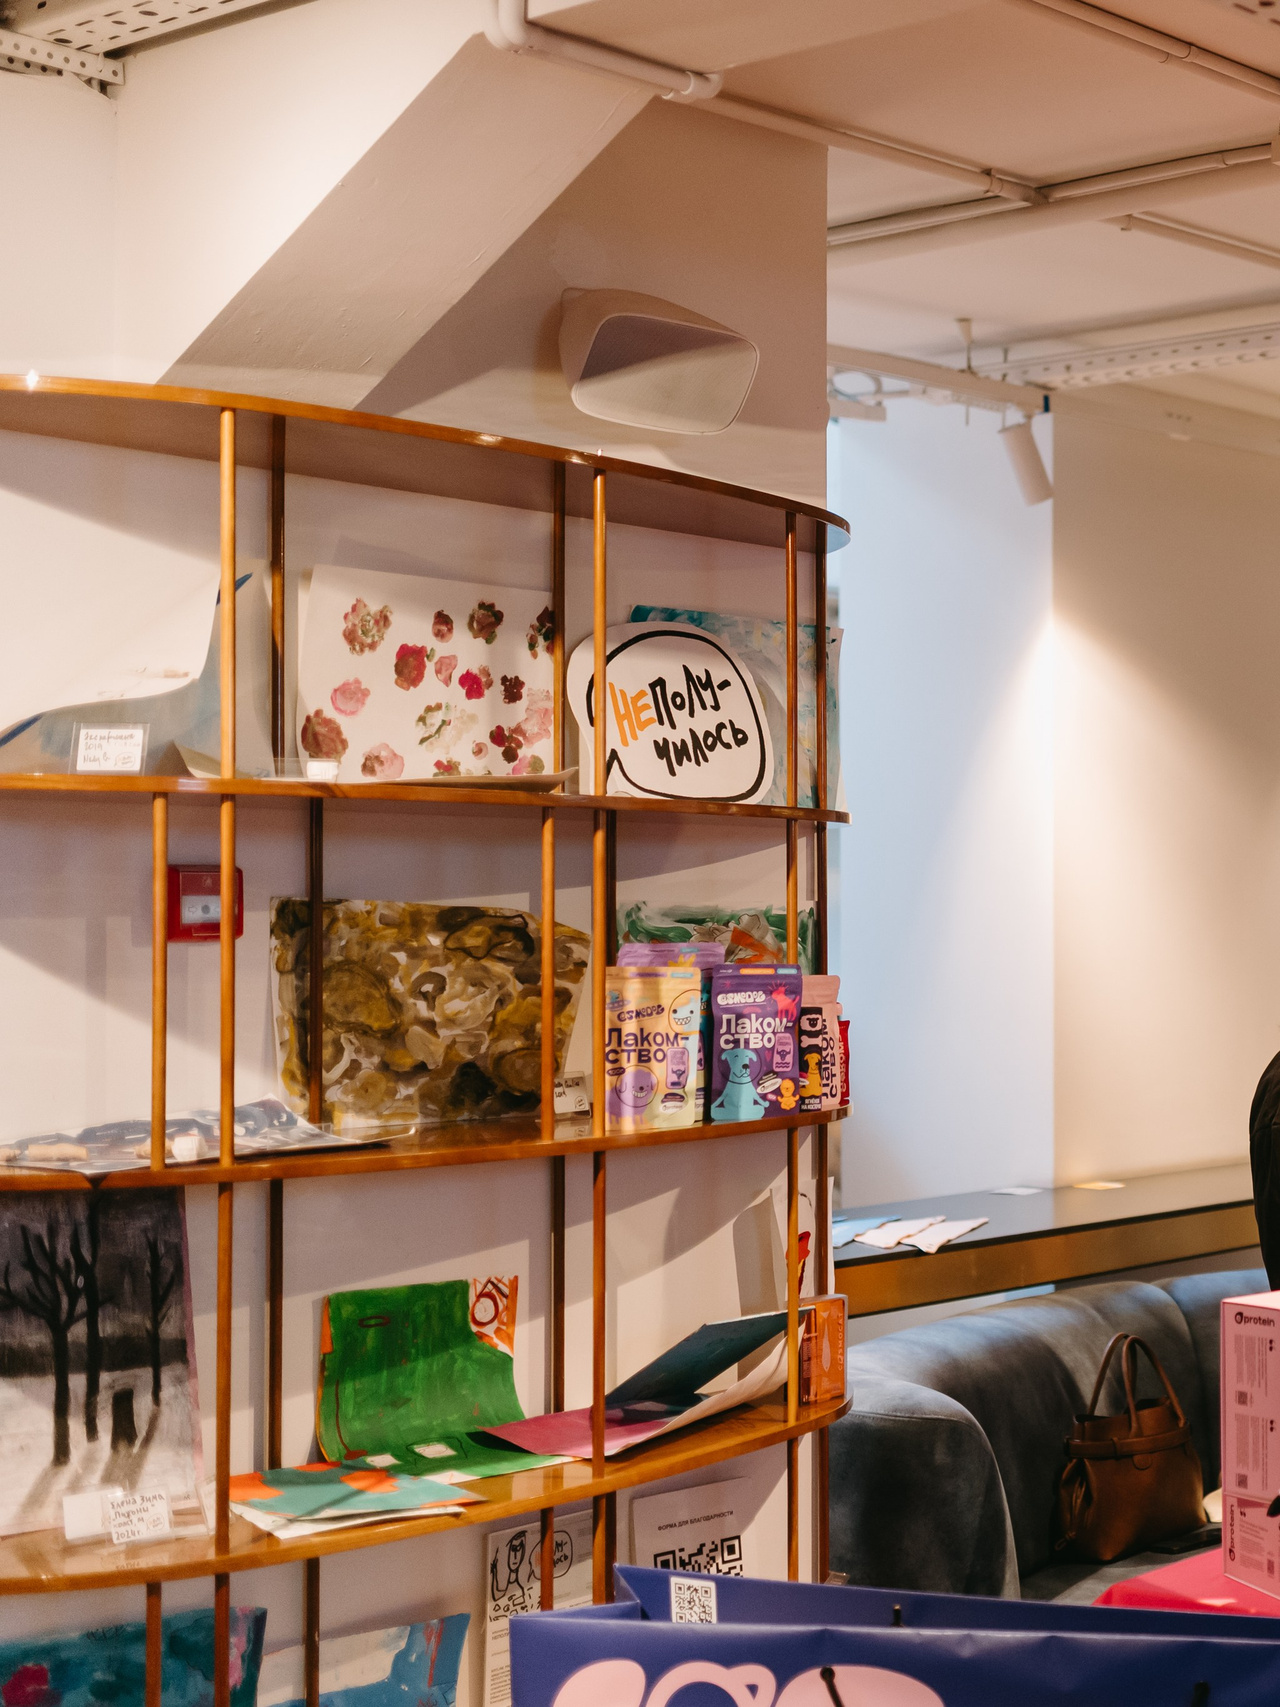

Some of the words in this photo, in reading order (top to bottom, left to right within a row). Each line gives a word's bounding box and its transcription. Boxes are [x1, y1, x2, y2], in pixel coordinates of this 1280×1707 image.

[658, 1523, 677, 1531] ФОРМА
[677, 1520, 689, 1528] ДЛЯ
[689, 1510, 734, 1525] БЛАГОДАРНОСТИ
